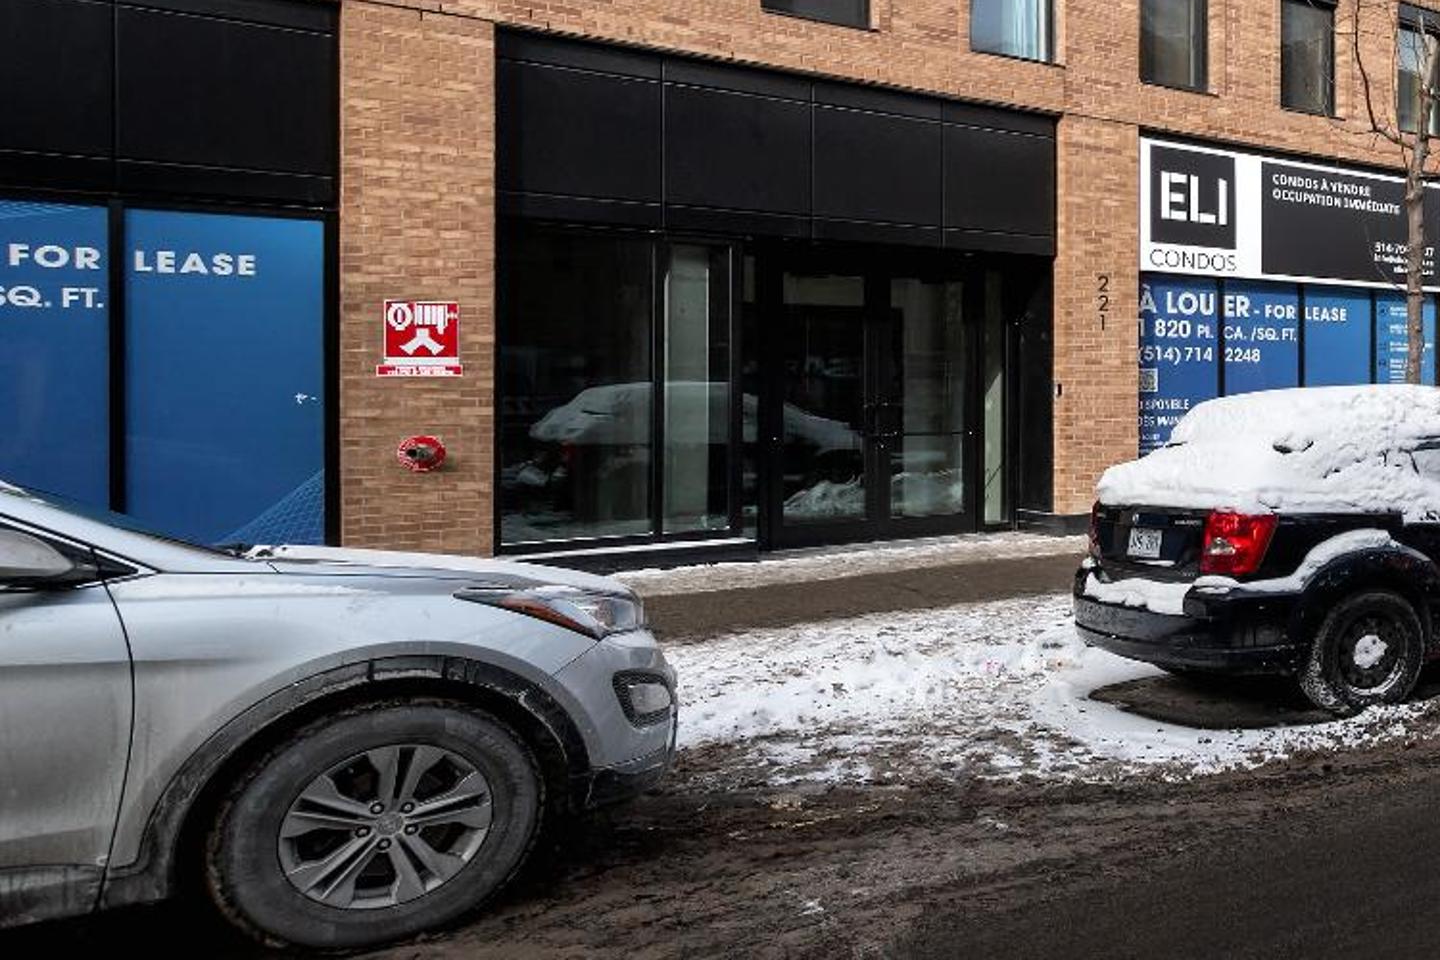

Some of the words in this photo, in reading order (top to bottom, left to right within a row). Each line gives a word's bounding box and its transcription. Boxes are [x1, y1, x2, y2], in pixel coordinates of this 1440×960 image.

[1160, 170, 1228, 226] ELI
[1272, 174, 1319, 190] CONDOS
[1320, 177, 1329, 191] À
[1330, 181, 1371, 197] VENDRE
[1272, 188, 1342, 208] OCCUPATION
[1343, 197, 1401, 216] IMMÉDIATE
[8, 243, 101, 270] FOR
[134, 250, 256, 276] LEASE
[1149, 248, 1237, 272] CONDOS
[62, 287, 104, 309] FT.
[1097, 275, 1110, 331] 221
[1138, 283, 1158, 314] À
[1264, 304, 1296, 320] FOR
[1305, 306, 1347, 322] LEASE
[1154, 319, 1192, 339] 820
[1223, 326, 1248, 341] CA.
[1184, 346, 1213, 362] 714
[1224, 348, 1261, 363] 2248
